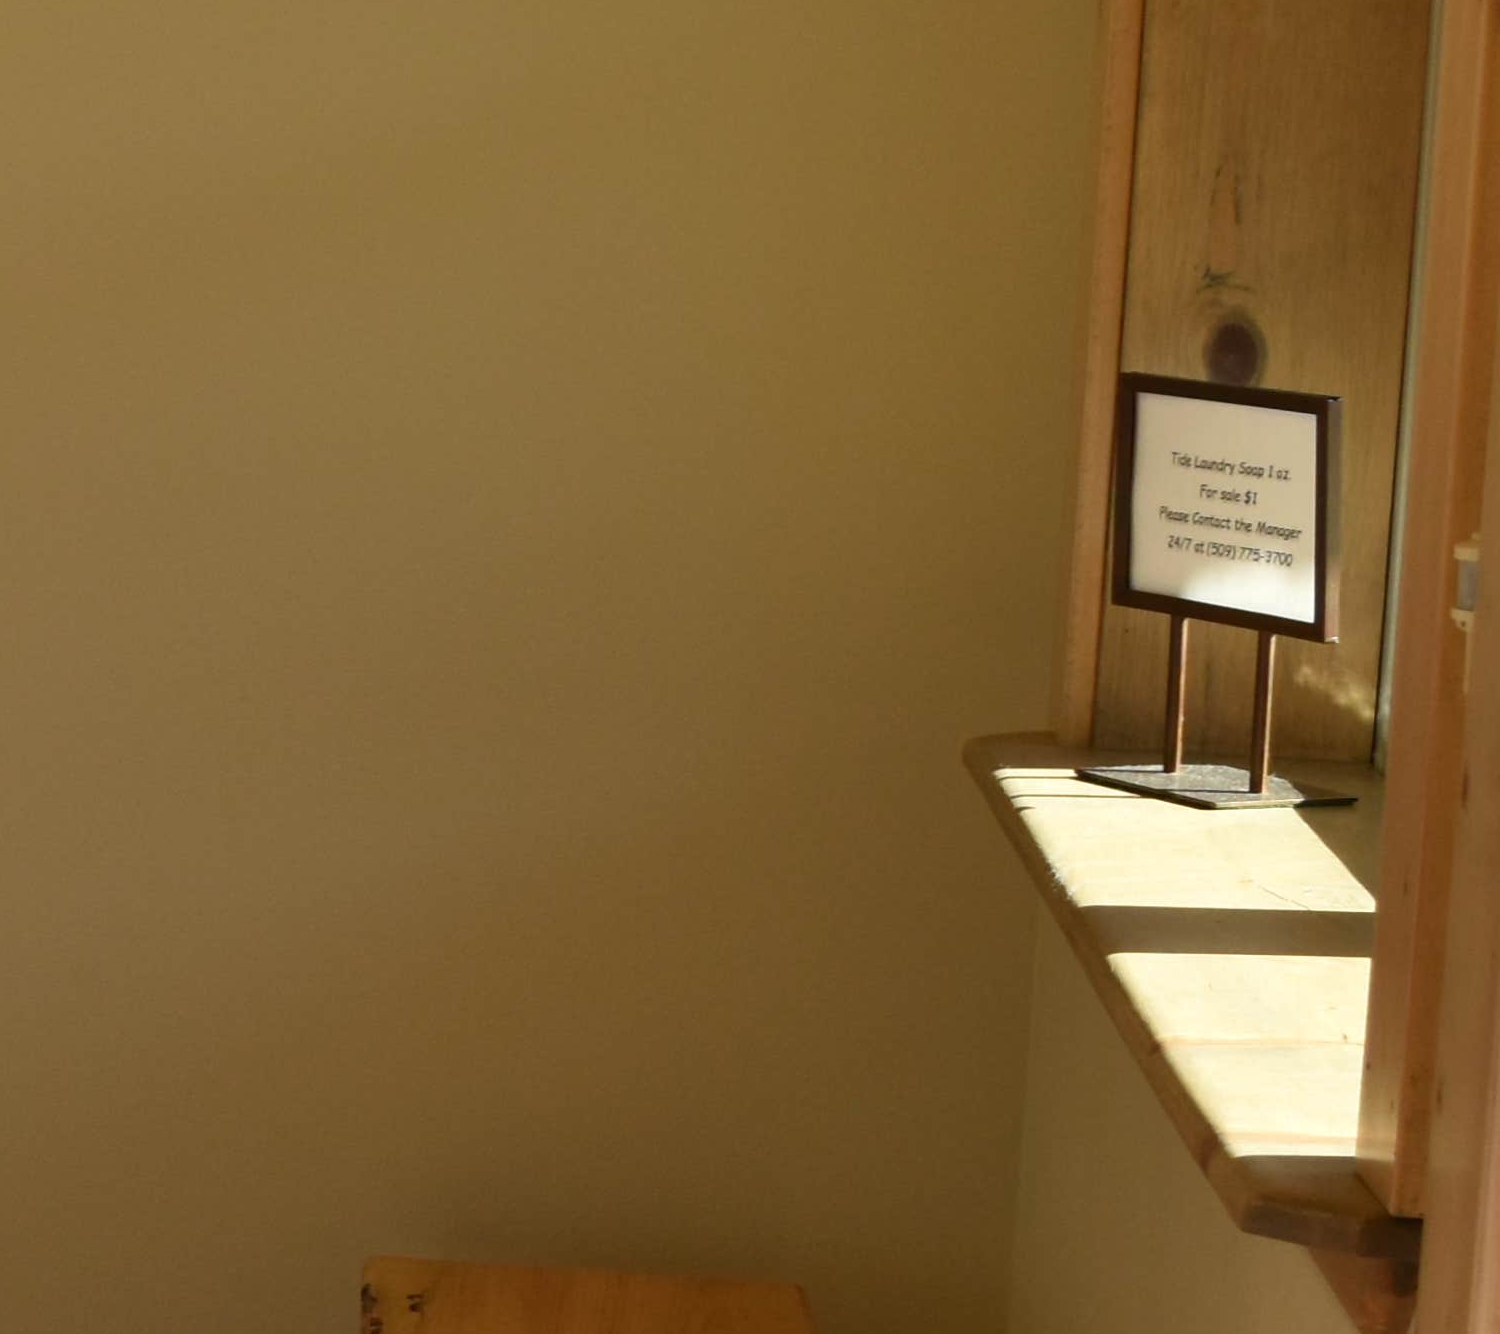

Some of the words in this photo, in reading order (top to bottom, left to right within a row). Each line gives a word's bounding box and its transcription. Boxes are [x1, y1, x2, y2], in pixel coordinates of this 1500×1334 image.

[1171, 452, 1192, 468] Tide
[1194, 456, 1236, 476] Laundry
[1238, 461, 1264, 479] Soap
[1199, 483, 1217, 499] For
[1220, 487, 1241, 503] sale
[1159, 505, 1190, 524] Please
[1192, 511, 1231, 530] Contact
[1234, 517, 1252, 533] the
[1255, 522, 1302, 541] Manager
[1168, 534, 1191, 550] 24/7
[1194, 539, 1205, 554] at
[1206, 541, 1236, 561] (509)
